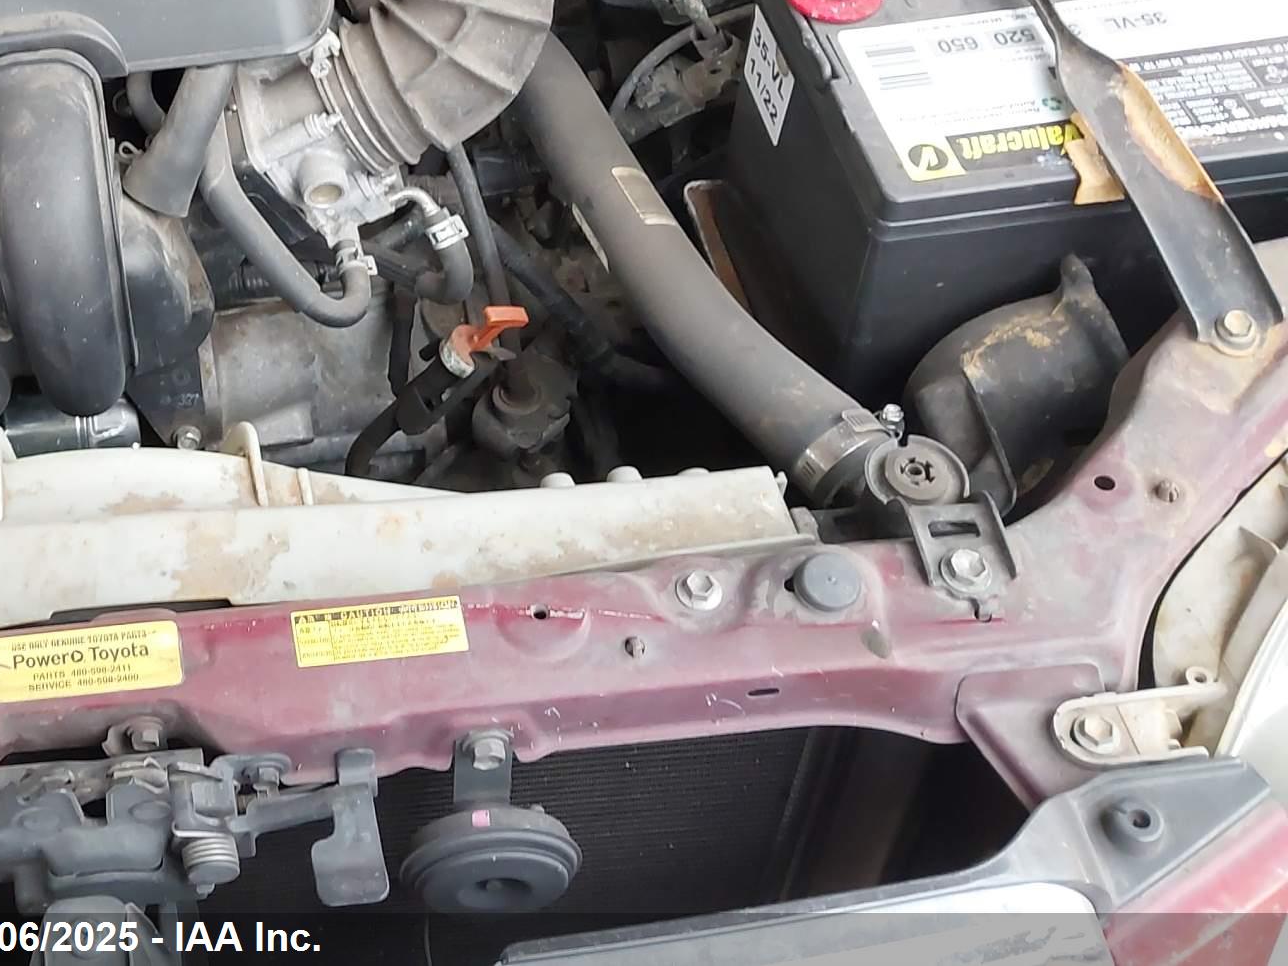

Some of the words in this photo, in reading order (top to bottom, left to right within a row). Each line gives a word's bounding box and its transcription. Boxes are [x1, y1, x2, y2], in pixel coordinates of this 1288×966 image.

[1104, 11, 1167, 30] 35-VL
[938, 35, 979, 54] 650
[994, 27, 1037, 46] 520
[754, 26, 784, 102] 35-VL
[750, 57, 778, 127] 11/22
[961, 123, 1084, 160] Valucraft
[87, 632, 119, 645] TOYOTA
[88, 643, 149, 662] Toyota
[33, 671, 66, 681] PARTS
[28, 681, 72, 692] SERVICE
